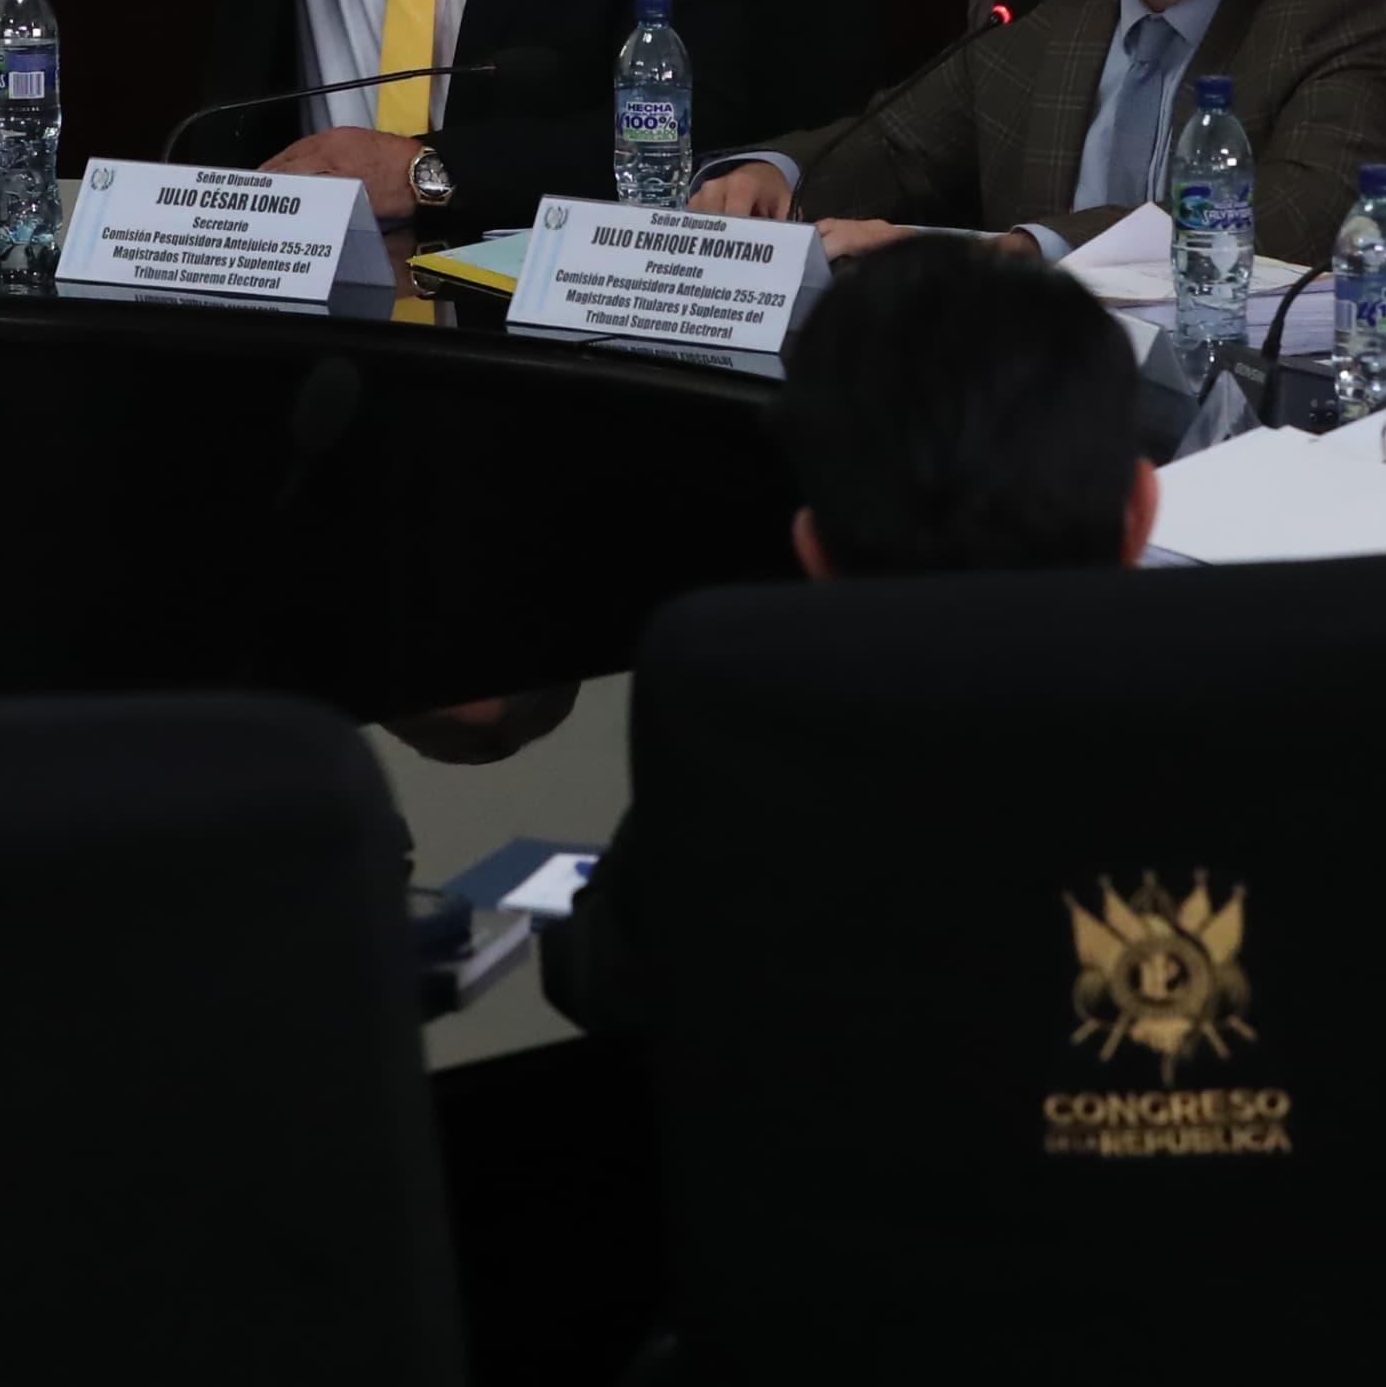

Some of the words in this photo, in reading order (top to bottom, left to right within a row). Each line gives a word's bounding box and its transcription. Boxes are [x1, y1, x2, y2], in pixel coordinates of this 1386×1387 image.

[628, 103, 672, 112] HECHA
[625, 116, 676, 129] 100%
[197, 171, 225, 185] Señor
[228, 173, 272, 188] Diputado
[156, 187, 198, 207] JULIO
[199, 189, 248, 211] CÉSAR
[251, 195, 300, 214] LONGO
[193, 217, 248, 232] Secretario
[651, 213, 679, 227] Señor
[682, 216, 726, 232] Diputado
[102, 228, 151, 242] Comisión
[153, 231, 222, 248] Pesquisidora
[224, 238, 278, 253] Antejuicio
[280, 242, 331, 257] 255-2023
[592, 227, 633, 247] JULIO
[635, 231, 696, 255] ENRIQUE
[699, 238, 773, 263] MONTANO
[113, 246, 178, 262] Magistrados
[181, 252, 227, 265] Titulares
[229, 257, 235, 268] y
[237, 256, 290, 272] Suplentes
[293, 262, 311, 273] del
[645, 261, 703, 278] Presidente
[134, 266, 178, 281] Tribunal
[180, 270, 226, 285] Supremo
[228, 274, 280, 289] Electroral
[556, 269, 604, 286] Comisión
[607, 275, 675, 294] Pesquisidora
[677, 283, 732, 301] Antejuicio
[733, 289, 786, 307] 255-2023
[566, 290, 630, 309] Magistrados
[633, 298, 679, 313] Titulares
[682, 304, 688, 315] y
[690, 304, 744, 322] Suplentes
[746, 311, 764, 323] del
[586, 310, 628, 327] Tribunal
[630, 315, 678, 332] Supremo
[680, 322, 733, 339] Electroral
